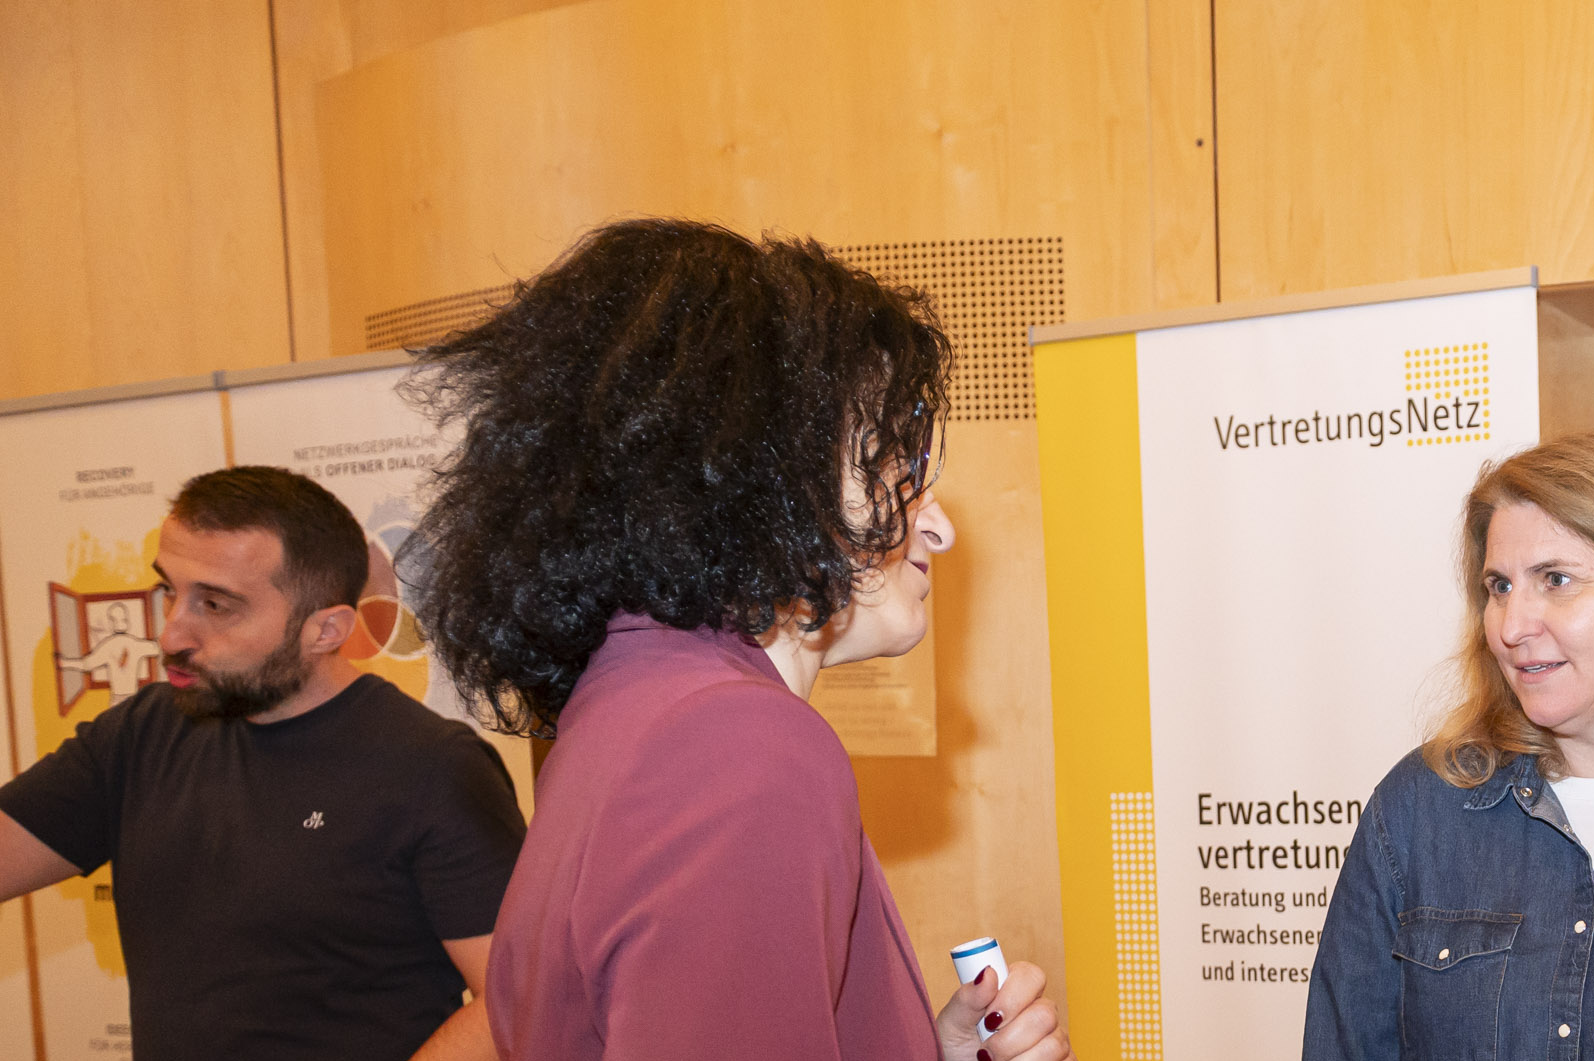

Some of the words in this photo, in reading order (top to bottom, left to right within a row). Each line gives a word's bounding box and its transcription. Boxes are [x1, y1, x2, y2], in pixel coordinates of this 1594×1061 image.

[1214, 397, 1481, 450] VertretungsNetz
[325, 459, 384, 476] OFFENER
[387, 453, 436, 471] DIALOG
[1198, 791, 1362, 826] Erwachsen
[1200, 887, 1286, 912] Beratung
[1292, 886, 1327, 907] und
[1202, 962, 1234, 982] und
